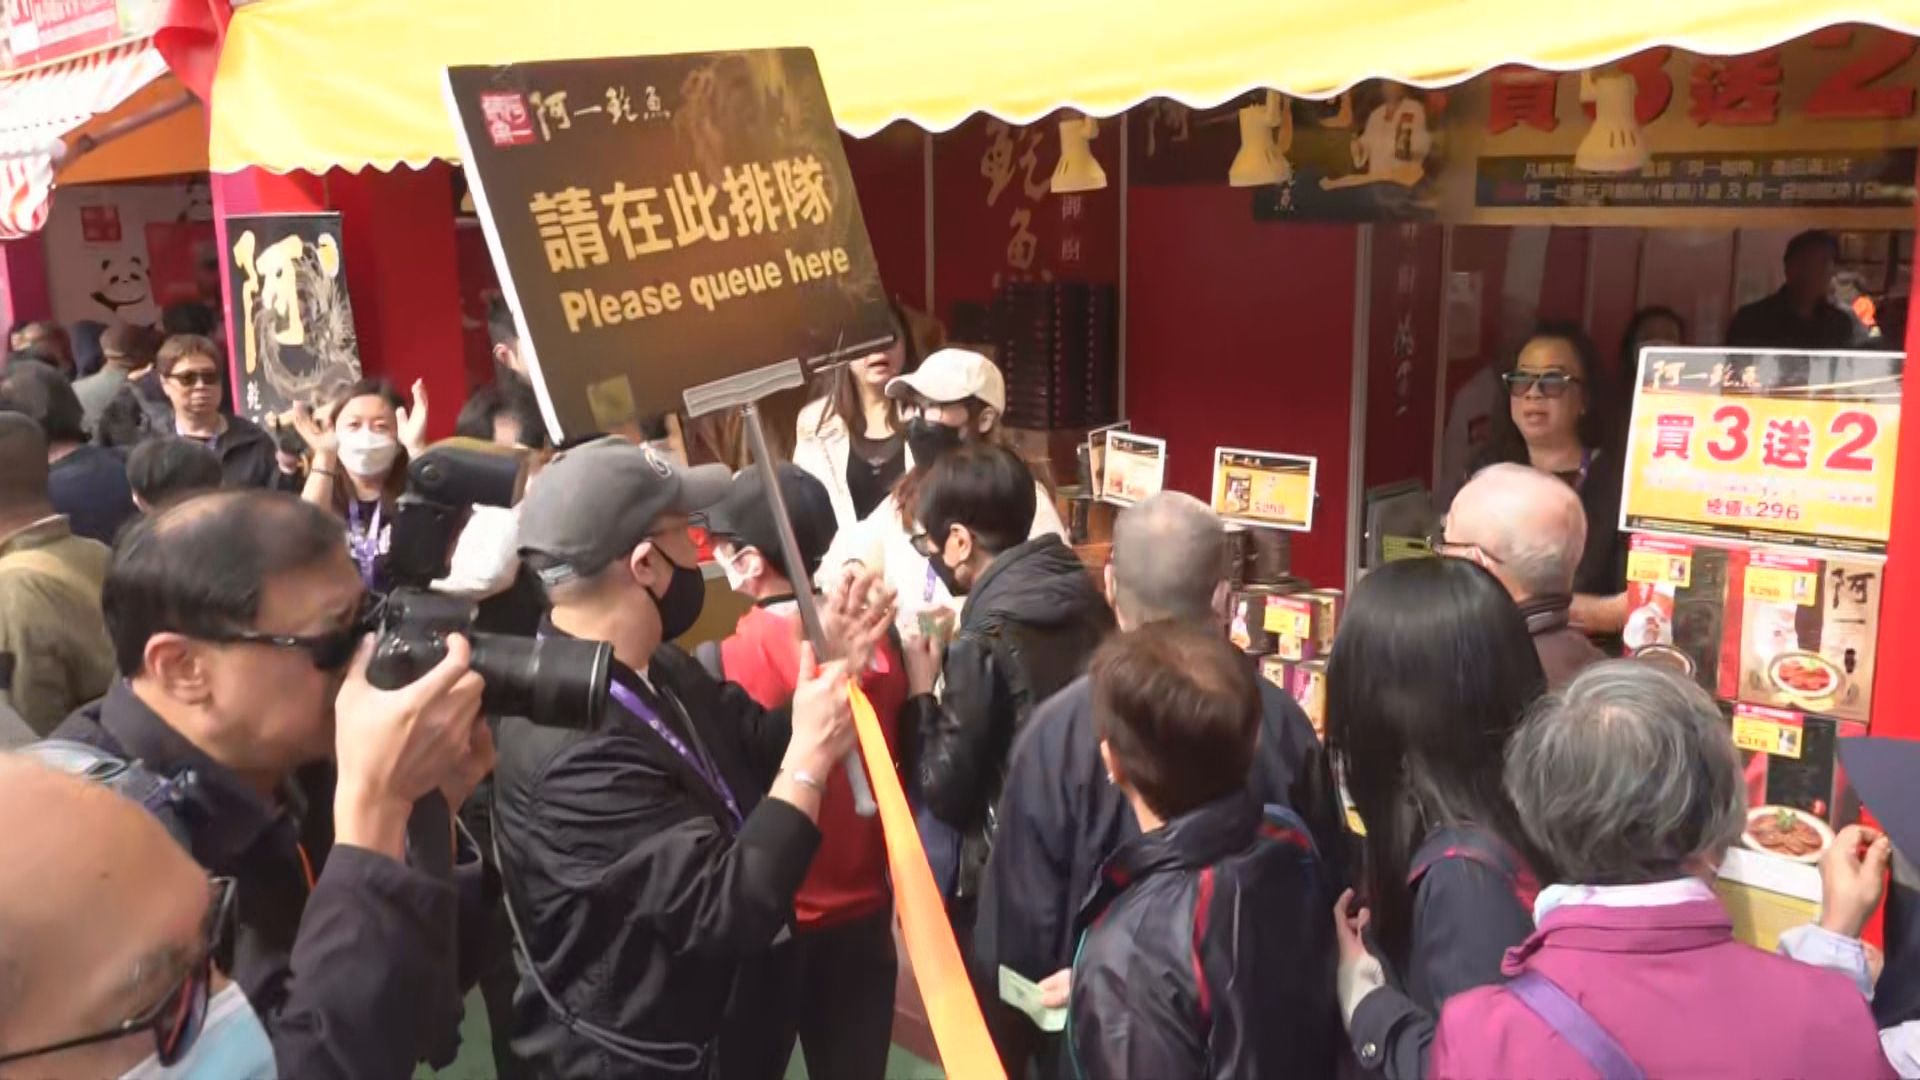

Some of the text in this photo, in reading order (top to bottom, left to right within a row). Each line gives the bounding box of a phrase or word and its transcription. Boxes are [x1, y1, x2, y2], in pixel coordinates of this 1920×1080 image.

[528, 154, 834, 274] 請在此排隊
[559, 243, 850, 333] Please queue here
[1653, 405, 1879, 472] 買3送2
